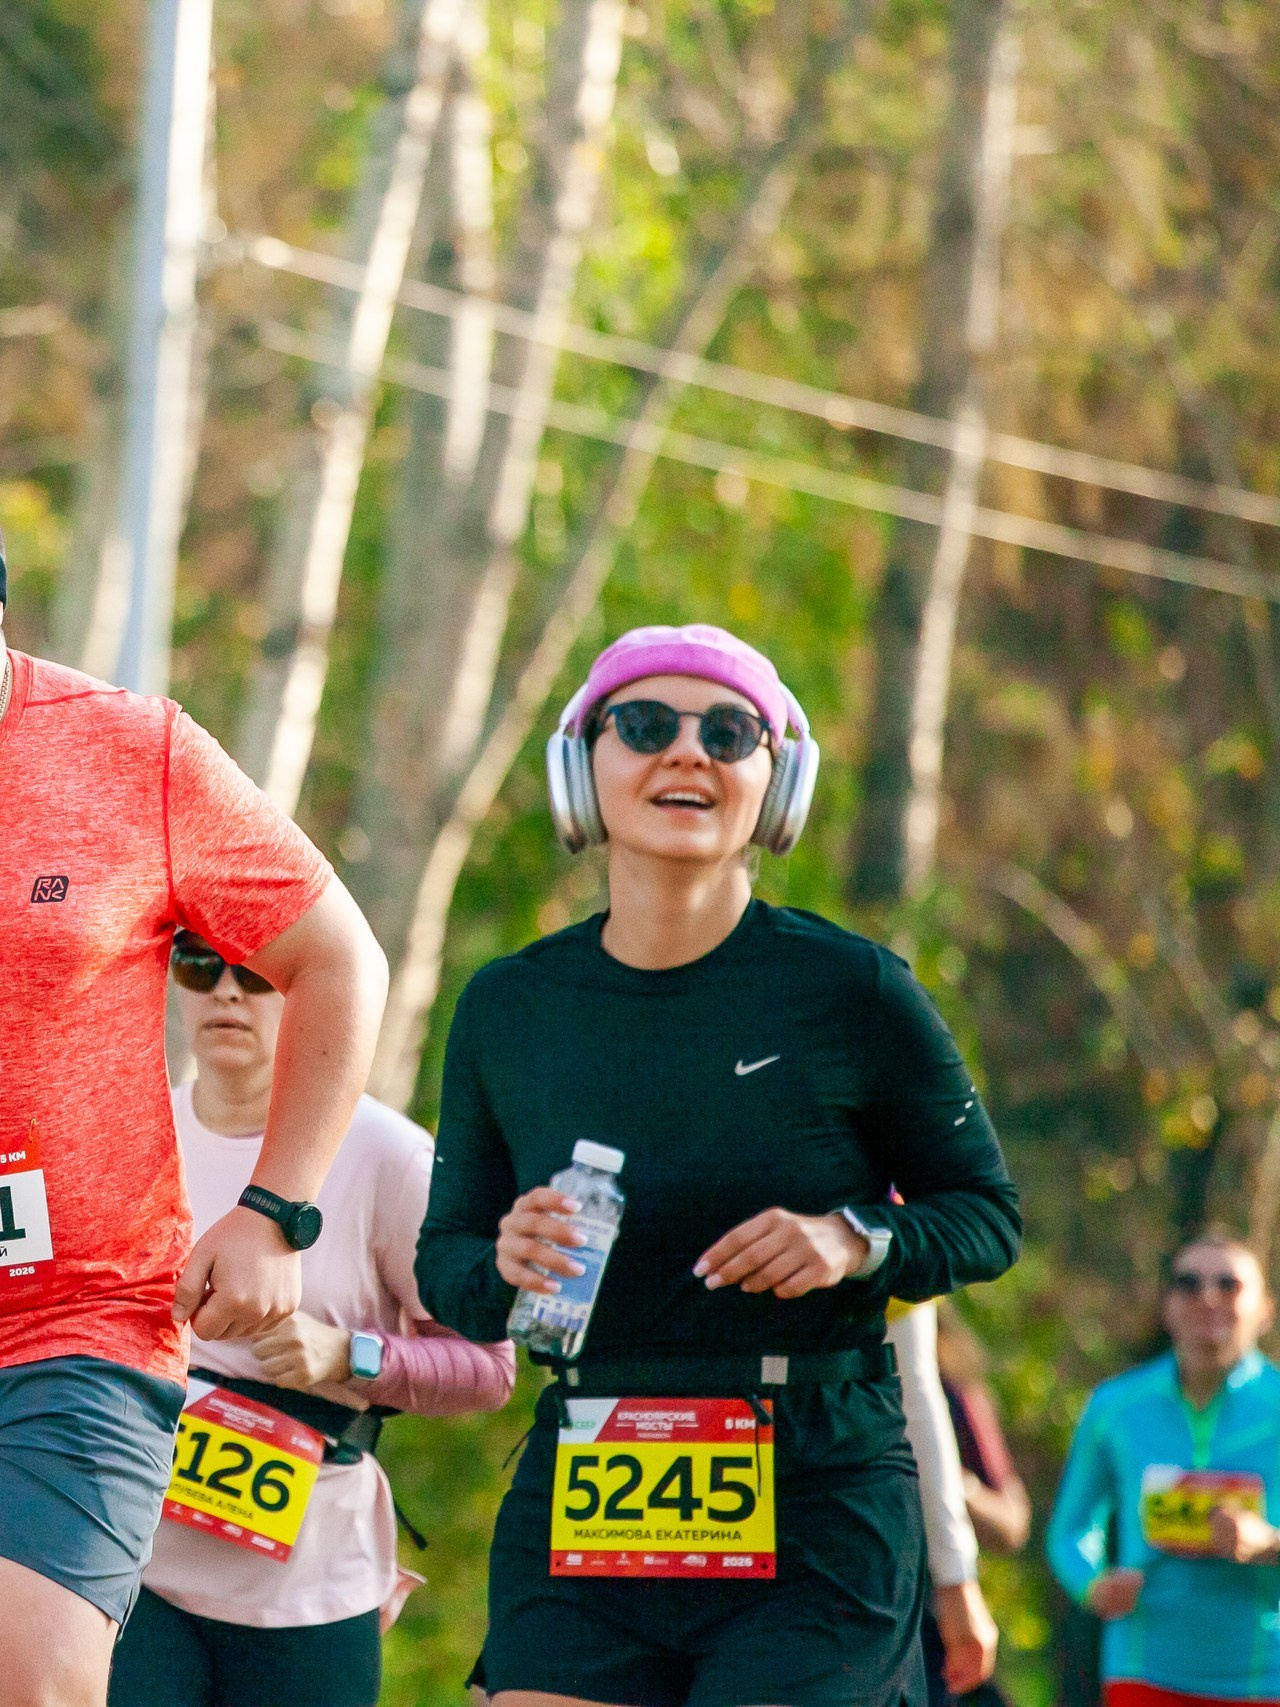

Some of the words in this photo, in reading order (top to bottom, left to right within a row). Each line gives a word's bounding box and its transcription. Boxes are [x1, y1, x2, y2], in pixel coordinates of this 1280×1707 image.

[0, 1154, 8, 1164] 5
[8, 1150, 27, 1163] КМ
[9, 1266, 35, 1277] 2026
[172, 1423, 295, 1513] 126
[564, 1454, 756, 1523] 5245
[573, 1528, 652, 1540] МАКСИМОВА
[656, 1529, 742, 1542] ЕКАТЕРИНА
